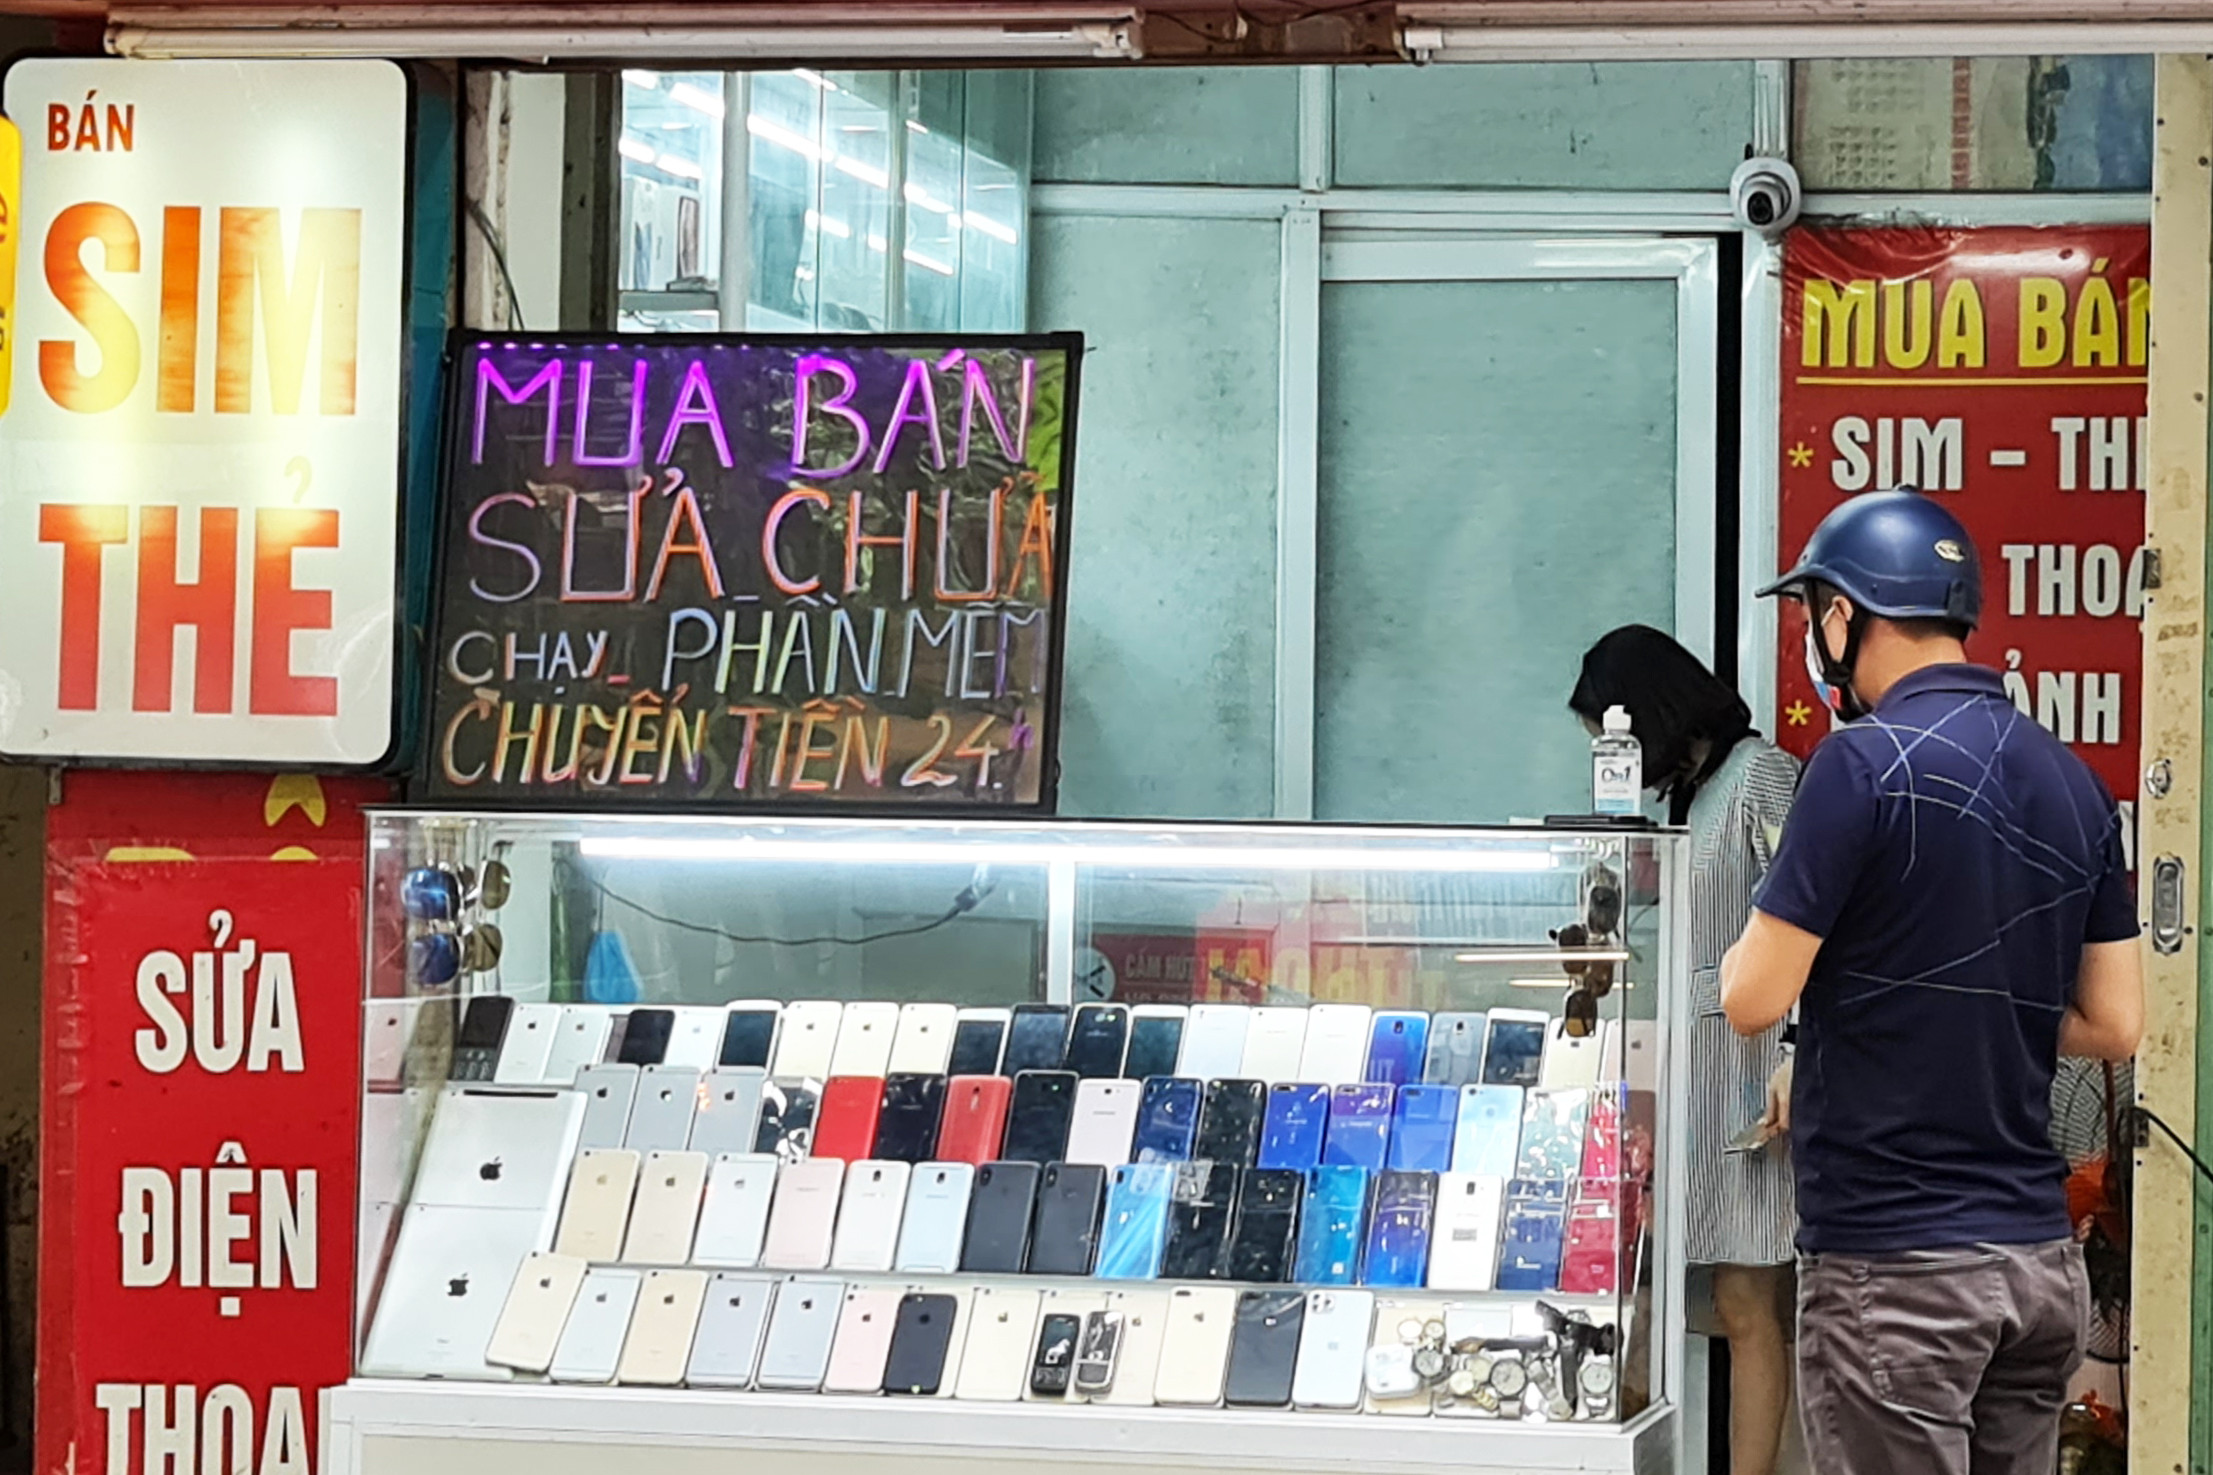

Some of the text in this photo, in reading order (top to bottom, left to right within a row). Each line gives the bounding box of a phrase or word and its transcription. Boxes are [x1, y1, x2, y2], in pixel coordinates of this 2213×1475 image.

[47, 90, 134, 152] BÁN
[38, 201, 363, 416] SIM
[1801, 277, 1986, 369] MUA
[472, 348, 1036, 478] MUA BÁN
[1831, 416, 1963, 491] SIM
[38, 455, 340, 716] THẺ
[447, 630, 609, 696] CHẠY
[662, 592, 886, 696] PHẦN
[134, 909, 305, 1074] SỬA
[118, 1141, 319, 1317] ĐIỆN
